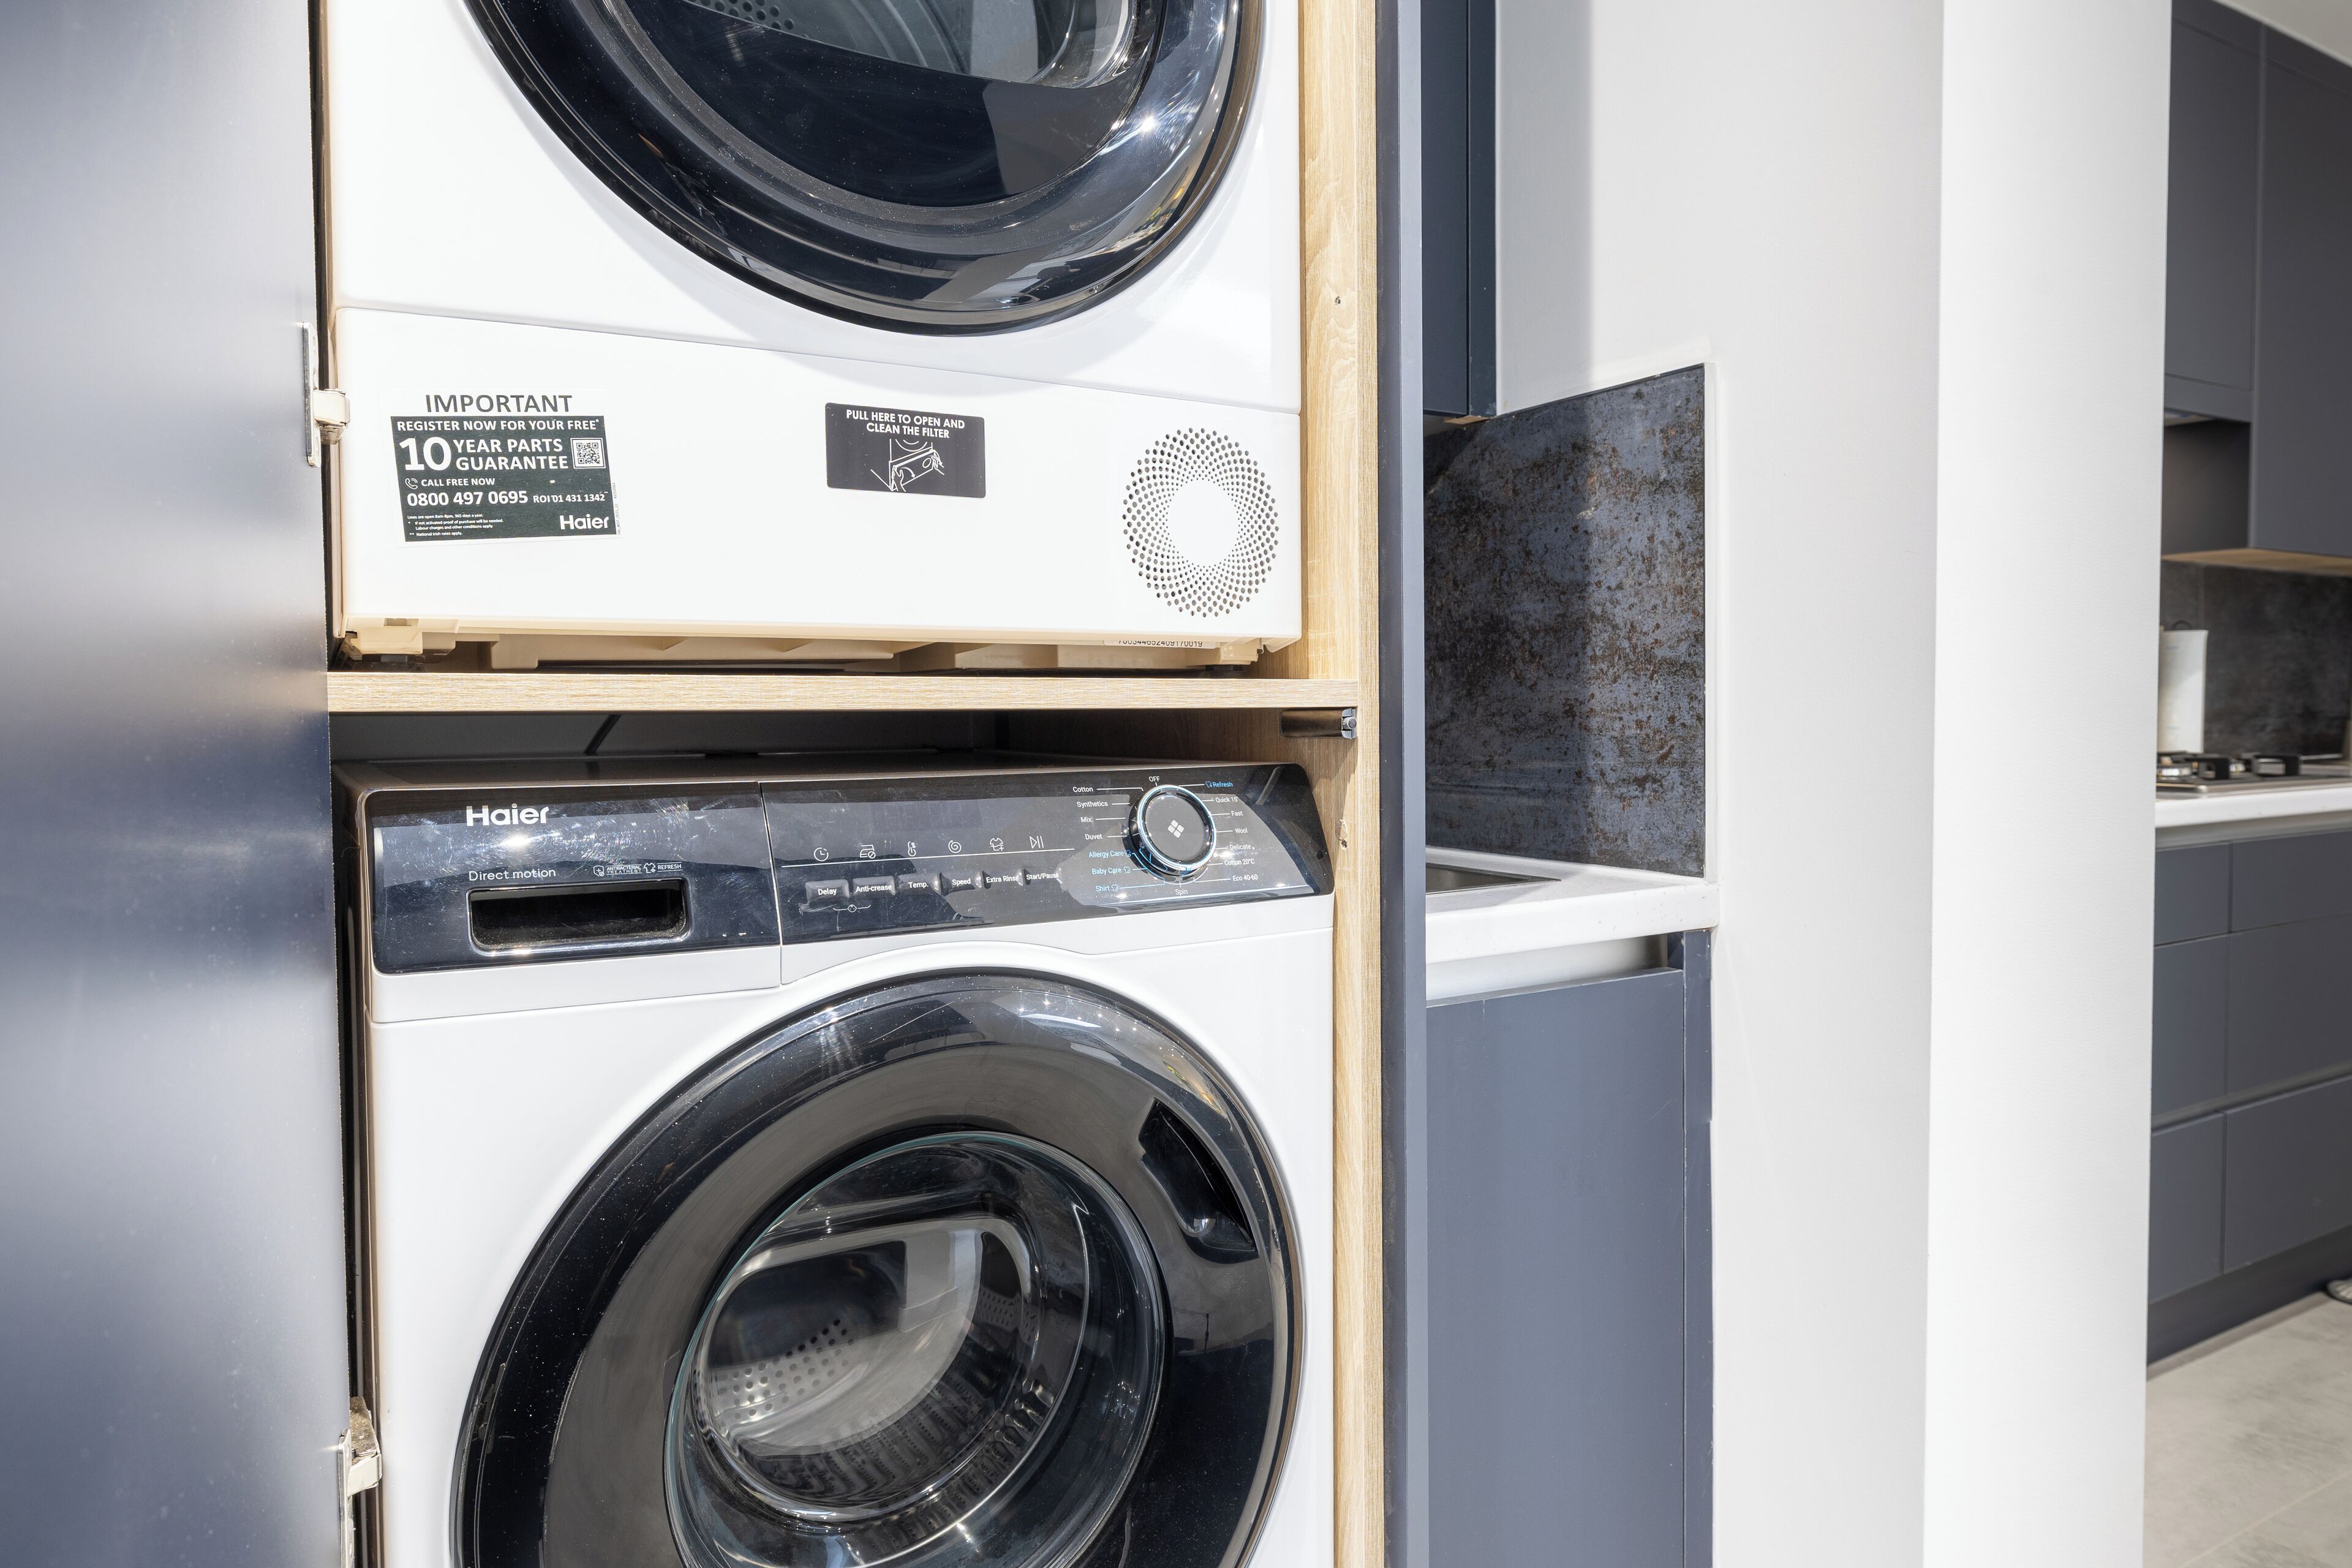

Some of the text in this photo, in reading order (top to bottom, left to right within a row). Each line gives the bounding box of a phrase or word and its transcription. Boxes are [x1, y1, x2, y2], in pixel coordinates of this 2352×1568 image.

[425, 394, 572, 413] IMPORTANT
[398, 420, 459, 431] REGISTER
[464, 421, 496, 430] NOW
[500, 421, 526, 430] FOR
[529, 420, 564, 430] YOUR
[846, 409, 965, 429] PULL HERE TO OPEN AND
[866, 422, 949, 439] CLEAN THE FILTER
[399, 437, 563, 470] 10 YEAR PARTS
[456, 456, 568, 470] GUARANTEE
[421, 478, 444, 487] CALL
[446, 478, 469, 486] FREE
[407, 491, 528, 506] 0800 497 0695
[559, 514, 609, 530] Haier
[466, 803, 549, 826] Haier
[469, 869, 556, 881] Direct motion
[856, 884, 892, 893] Anti-crease
